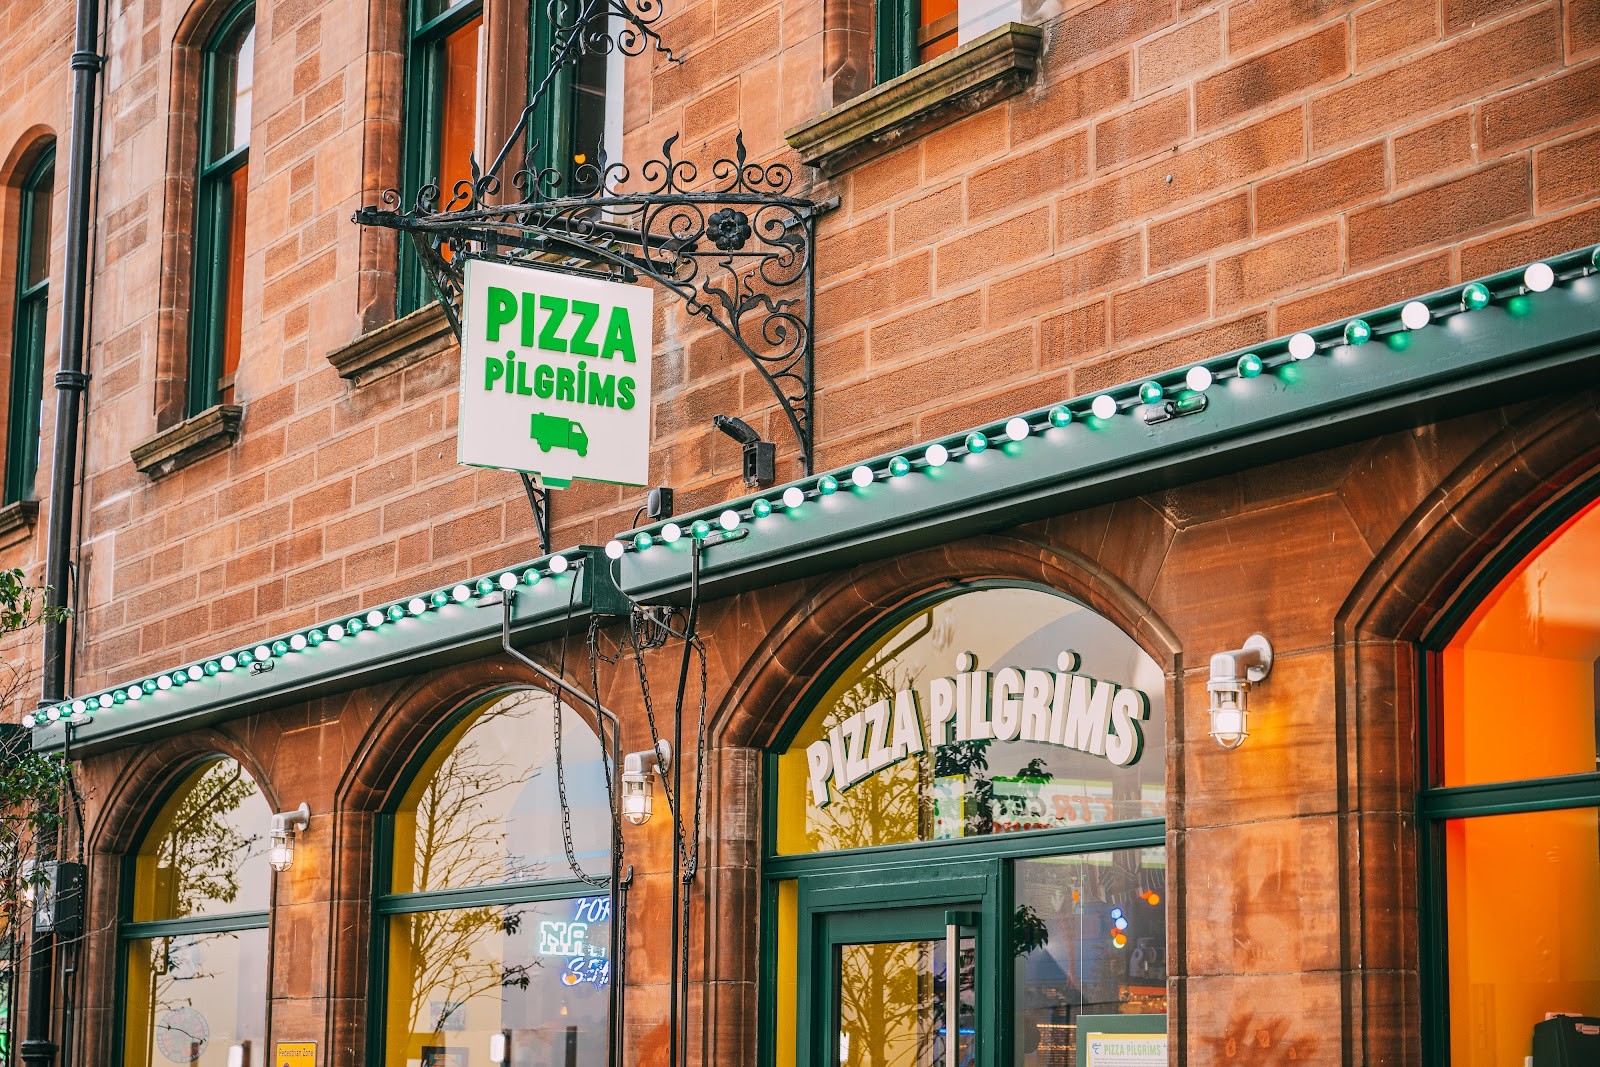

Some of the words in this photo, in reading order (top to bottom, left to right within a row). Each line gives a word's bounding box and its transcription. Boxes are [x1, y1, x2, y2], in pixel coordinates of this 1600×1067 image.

[486, 286, 637, 363] PIZZA
[806, 688, 926, 808] PIZZA
[279, 1048, 301, 1057] Pedestrian
[303, 1048, 314, 1057] Zone
[1104, 1044, 1125, 1056] PIZZA
